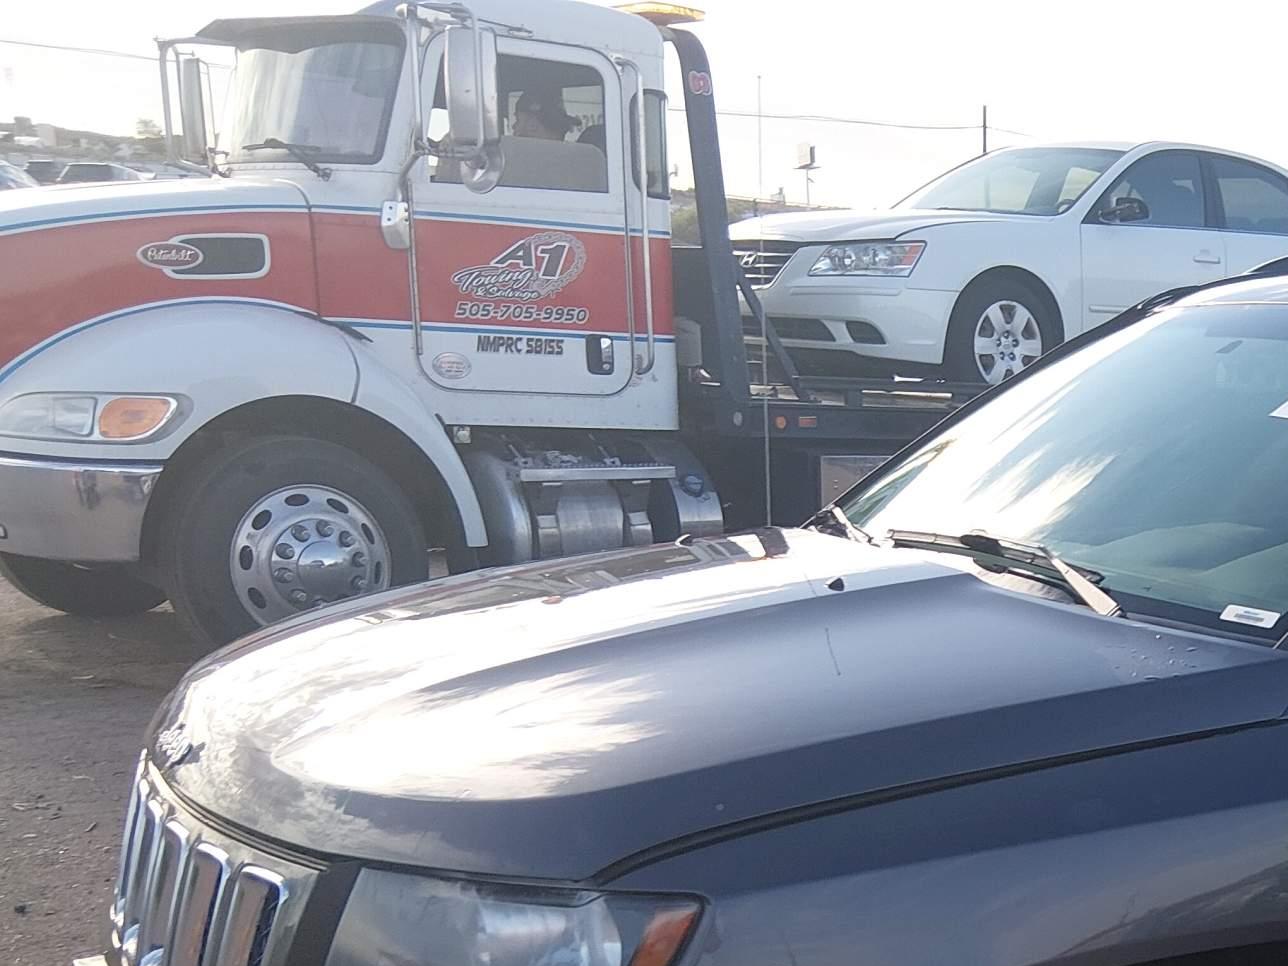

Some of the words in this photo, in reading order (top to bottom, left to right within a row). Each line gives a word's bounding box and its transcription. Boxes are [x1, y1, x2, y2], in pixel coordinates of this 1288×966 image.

[489, 240, 569, 280] A1
[453, 265, 536, 293] Towing
[455, 302, 589, 324] 505-705-9950
[477, 335, 523, 354] NMPRC
